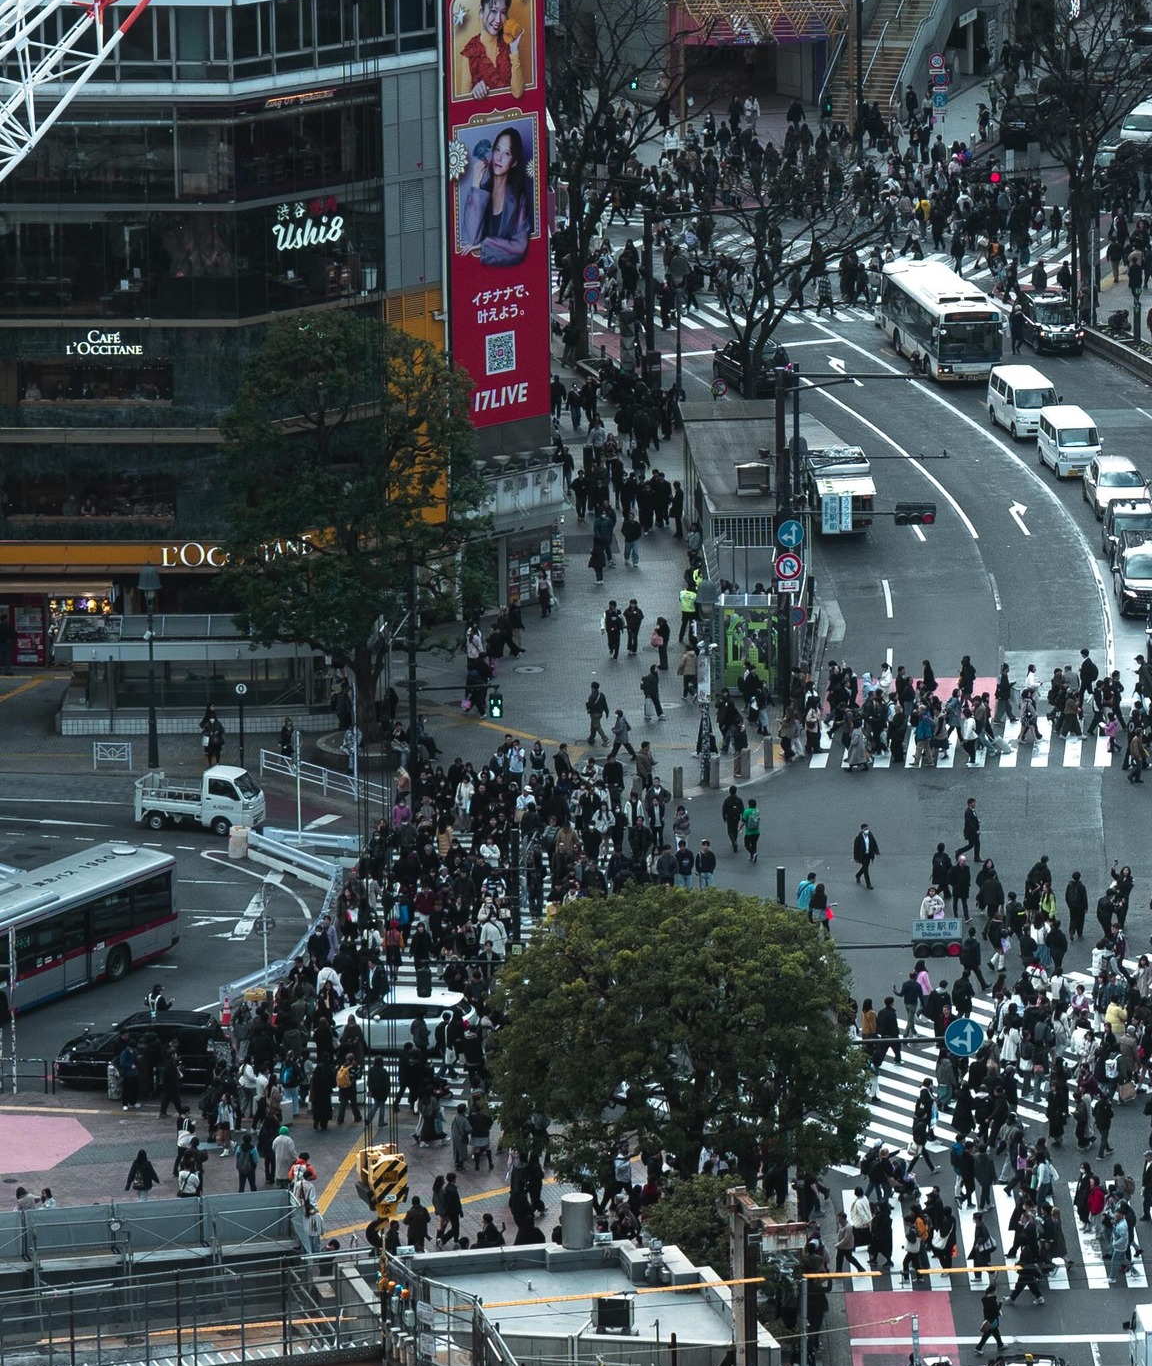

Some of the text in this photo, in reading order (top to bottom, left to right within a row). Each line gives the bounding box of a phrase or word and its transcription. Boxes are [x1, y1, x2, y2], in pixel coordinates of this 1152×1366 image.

[277, 202, 306, 222] 渋谷
[272, 215, 344, 252] Ushi8
[472, 283, 531, 308] イチナナで、
[476, 307, 526, 325] 叶えよう。
[66, 340, 143, 356] L'OCCITANE
[474, 382, 529, 413] 17LIVE
